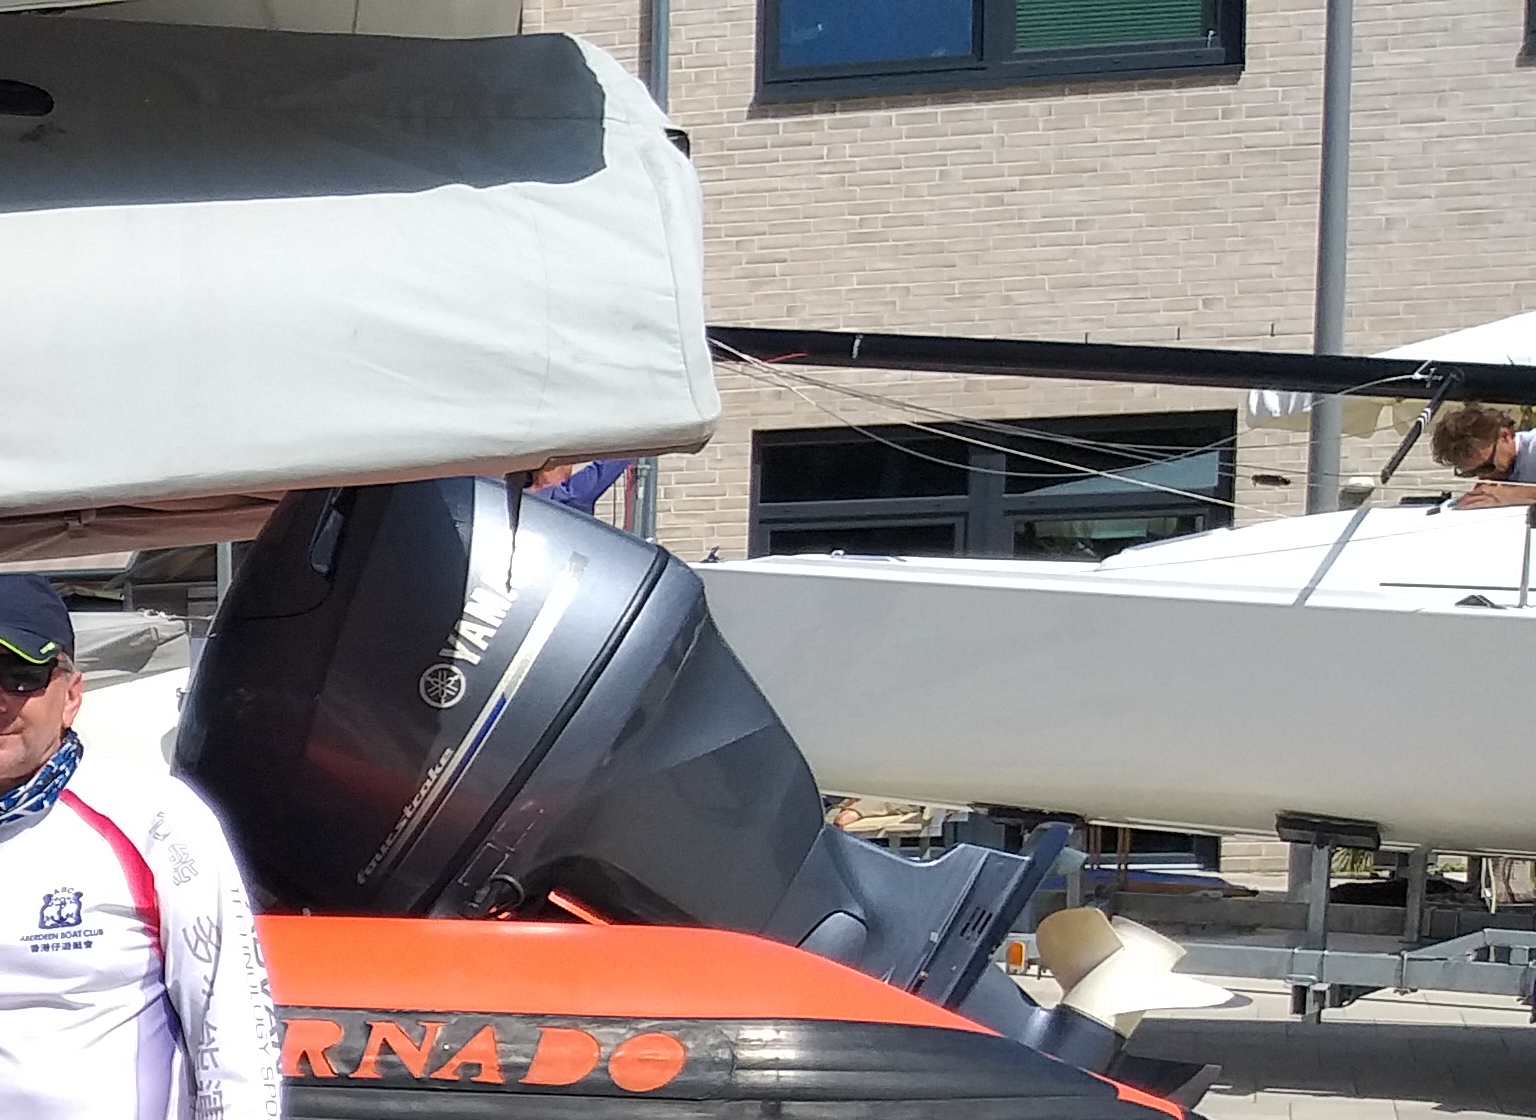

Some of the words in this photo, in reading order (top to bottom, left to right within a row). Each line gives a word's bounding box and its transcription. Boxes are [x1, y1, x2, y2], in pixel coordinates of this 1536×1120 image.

[355, 747, 455, 886] fourstroke
[60, 929, 83, 940] BOAT
[82, 928, 104, 938] CLUB
